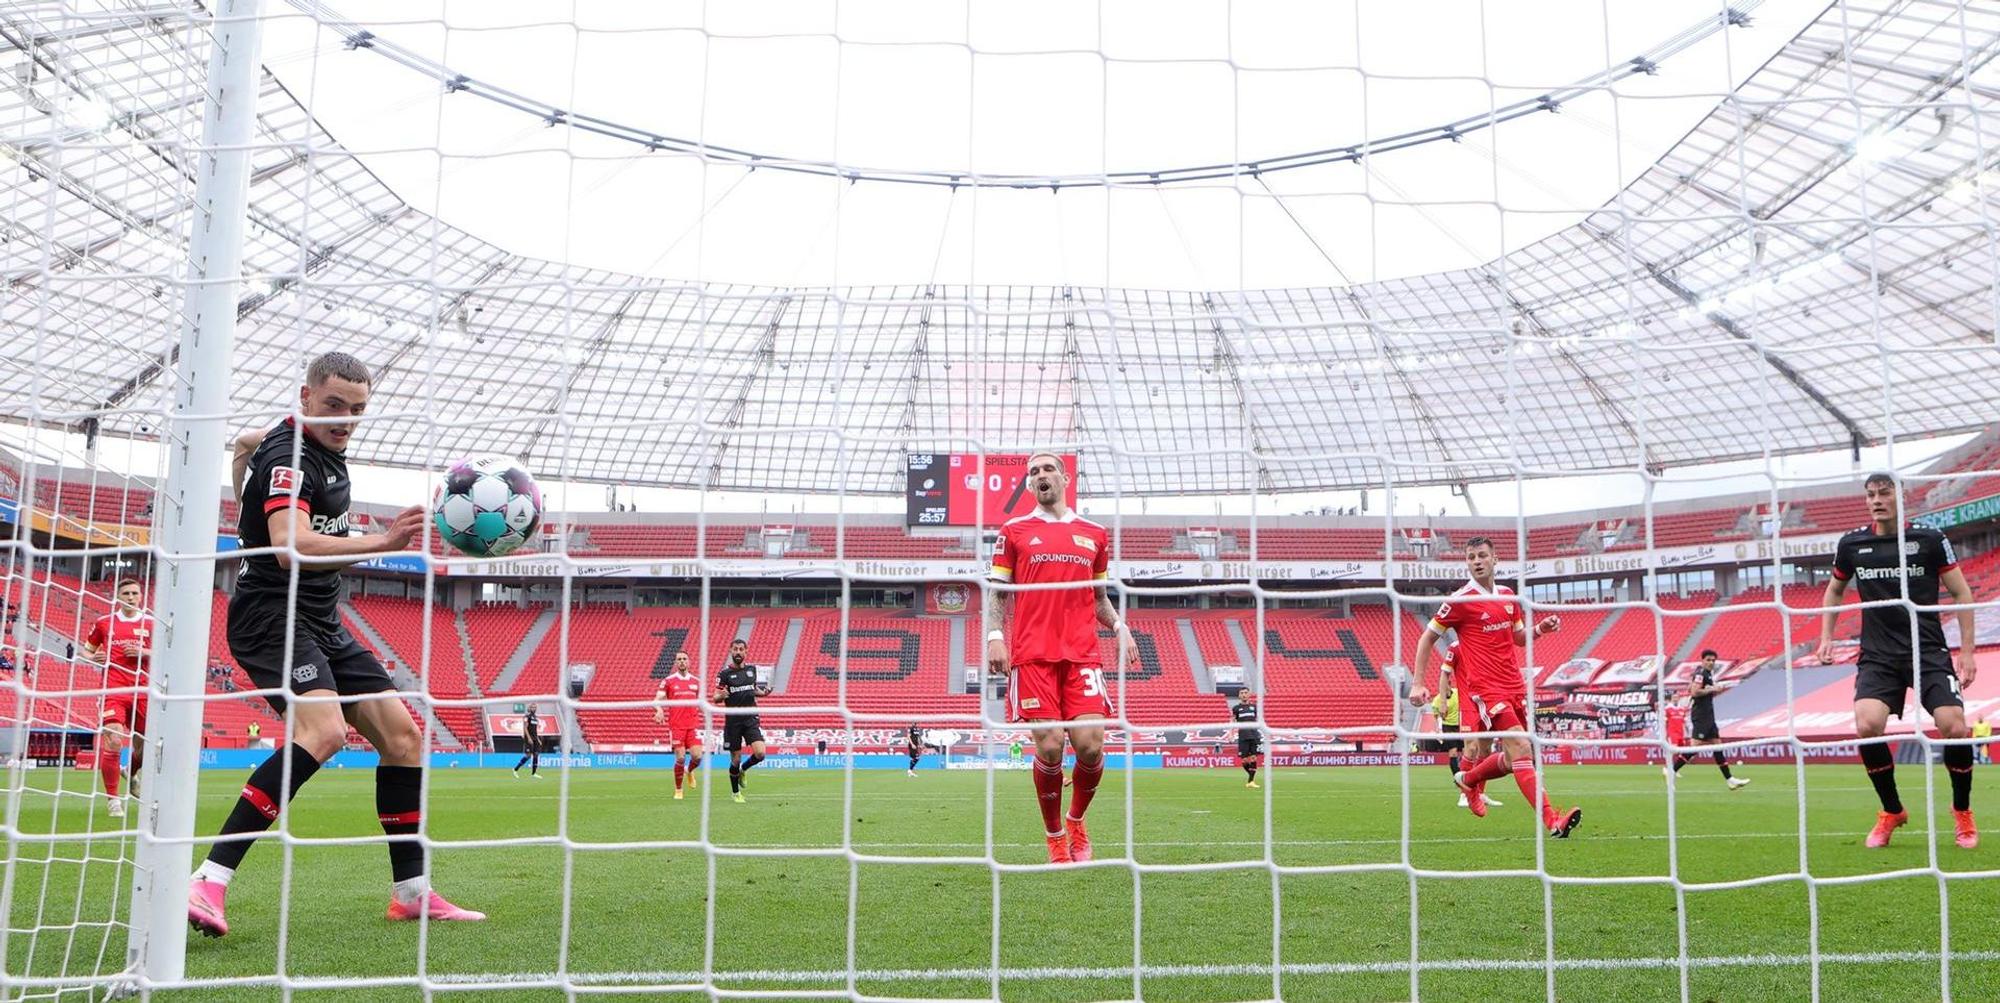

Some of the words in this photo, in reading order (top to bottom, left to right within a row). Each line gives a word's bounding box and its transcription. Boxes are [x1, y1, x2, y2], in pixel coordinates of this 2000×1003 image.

[985, 457, 1028, 466] SPIELSTA
[989, 475, 1002, 491] 0
[919, 513, 946, 522] 25:57
[1757, 542, 1835, 558] Biburger
[1030, 554, 1092, 568] AROUNDTOWN
[1575, 557, 1643, 573] Bitburger
[540, 755, 591, 768] armnia
[757, 755, 808, 769] armenia
[814, 755, 858, 767] EINFAC.
[1166, 757, 1204, 767] KUMHO
[1208, 757, 1234, 767] TYRE
[1291, 756, 1310, 766] AUF
[1312, 756, 1346, 766] KUMHO
[1348, 755, 1386, 765] REIFEN
[1390, 754, 1435, 764] WECSELN
[1541, 753, 1562, 764] YRE
